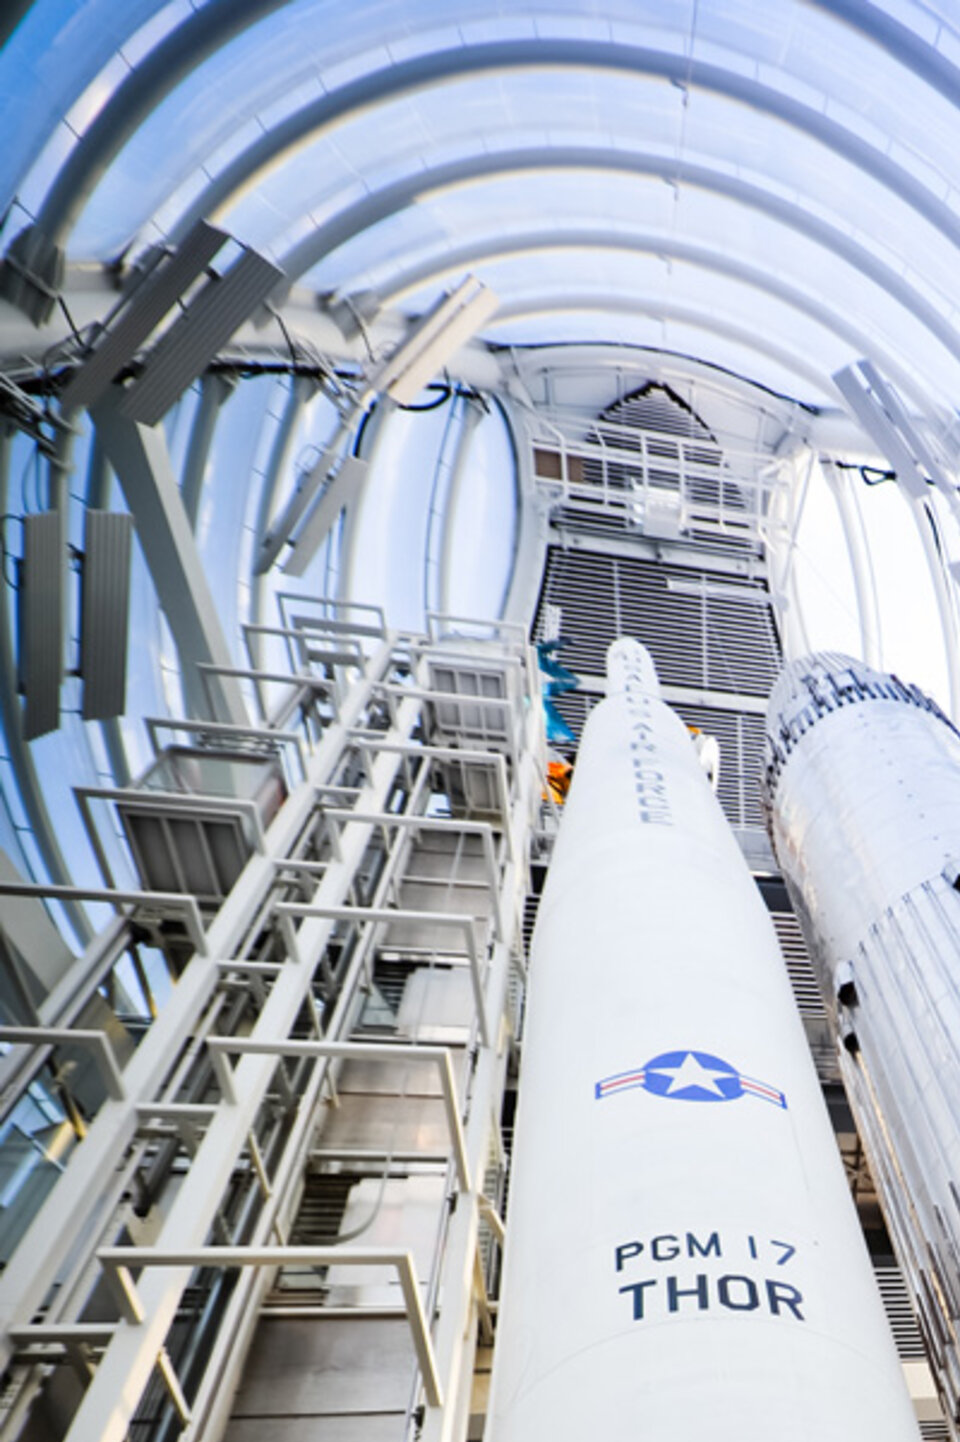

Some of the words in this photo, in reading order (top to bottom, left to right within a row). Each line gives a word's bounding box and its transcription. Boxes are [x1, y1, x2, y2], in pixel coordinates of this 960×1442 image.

[633, 758, 674, 826] FORCE
[615, 1231, 722, 1272] PGM
[748, 1235, 797, 1266] 17
[618, 1273, 806, 1322] THOR
